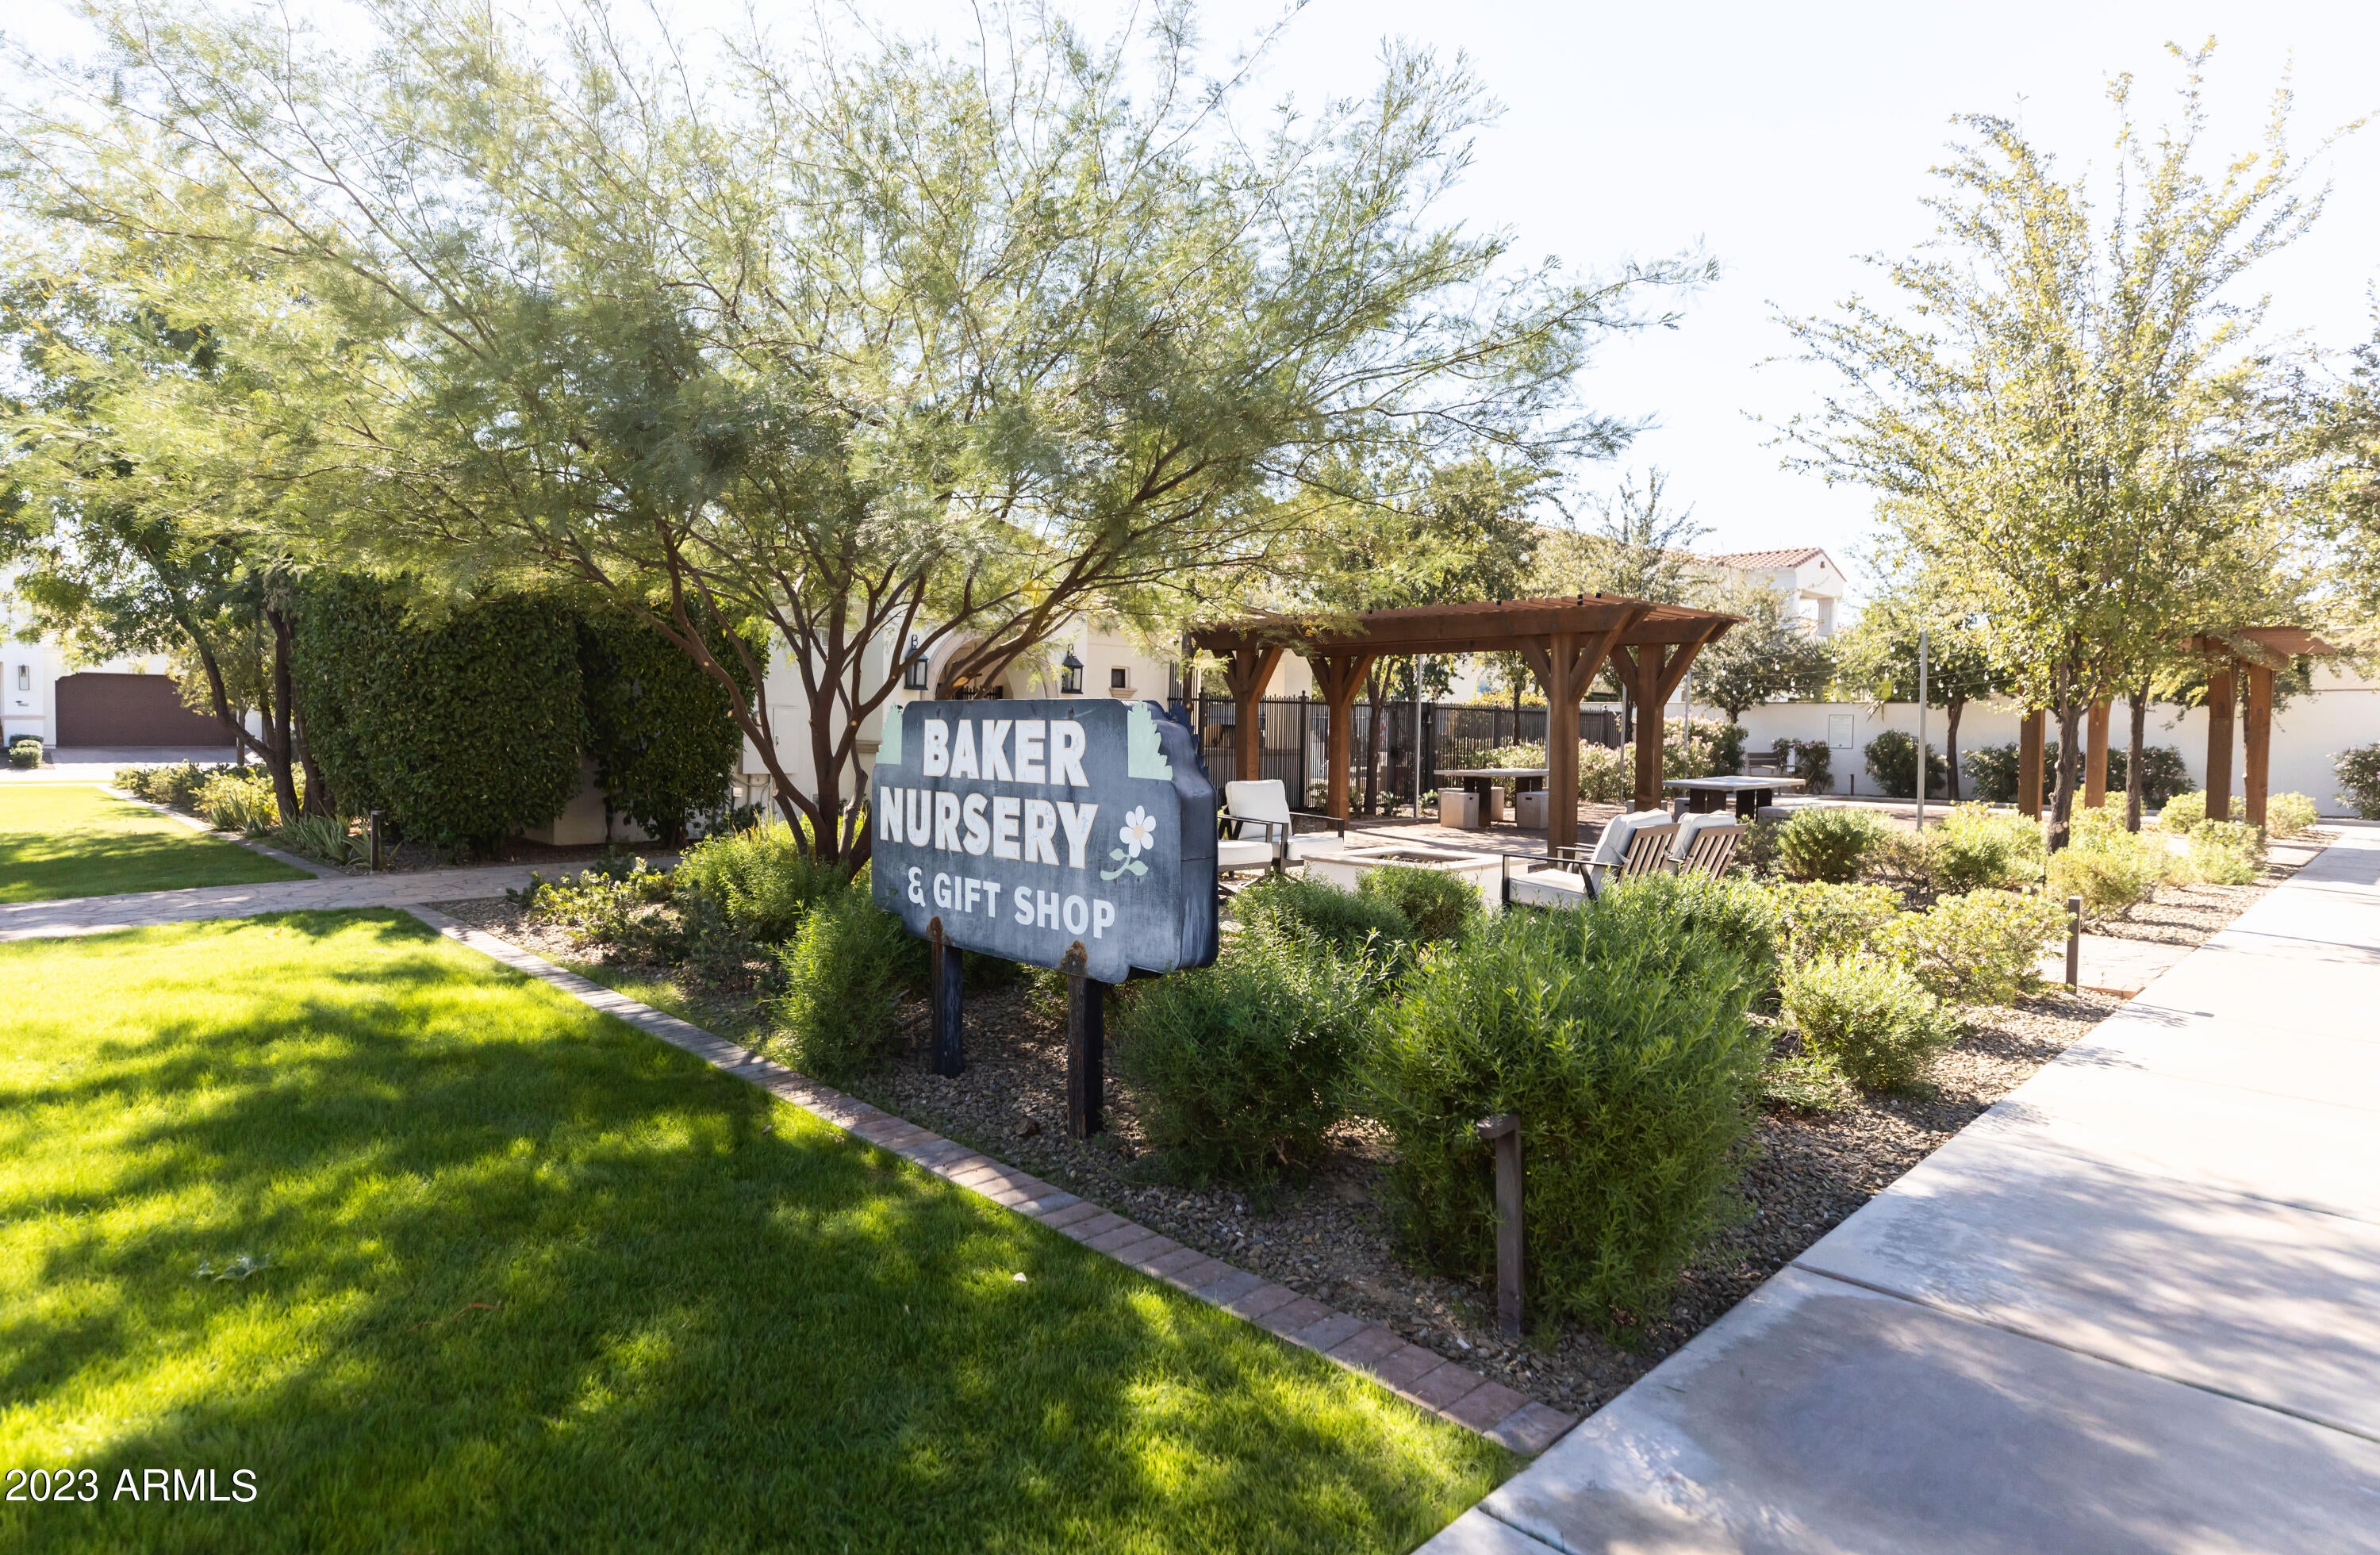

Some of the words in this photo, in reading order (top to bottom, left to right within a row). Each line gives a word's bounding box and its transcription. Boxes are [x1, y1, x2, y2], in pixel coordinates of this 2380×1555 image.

[923, 719, 1089, 787] BAKER
[879, 786, 1099, 870] NURSERY
[908, 866, 926, 907] &
[933, 873, 1000, 918] GIFT
[1014, 886, 1115, 939] SHOP
